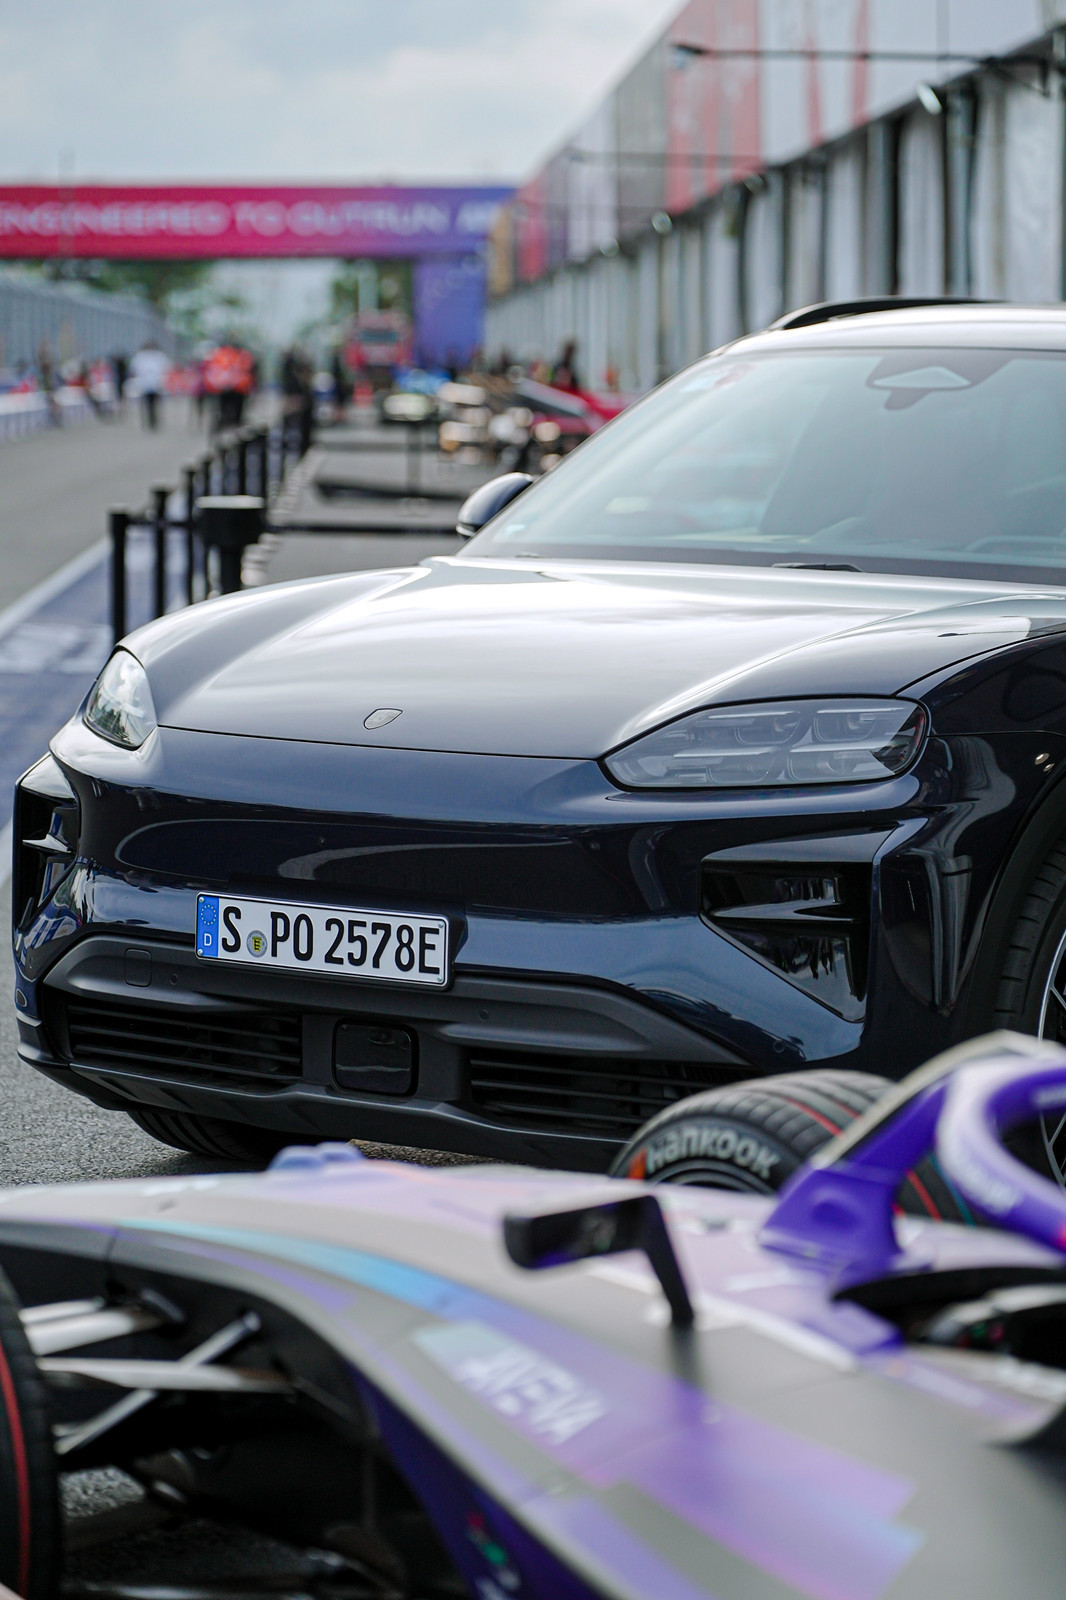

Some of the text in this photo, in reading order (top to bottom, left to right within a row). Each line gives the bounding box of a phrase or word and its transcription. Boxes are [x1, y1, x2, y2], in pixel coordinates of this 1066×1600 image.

[0, 200, 230, 237] NGINEERED
[203, 933, 212, 947] D
[221, 906, 242, 953] S
[324, 918, 440, 975] 2578E
